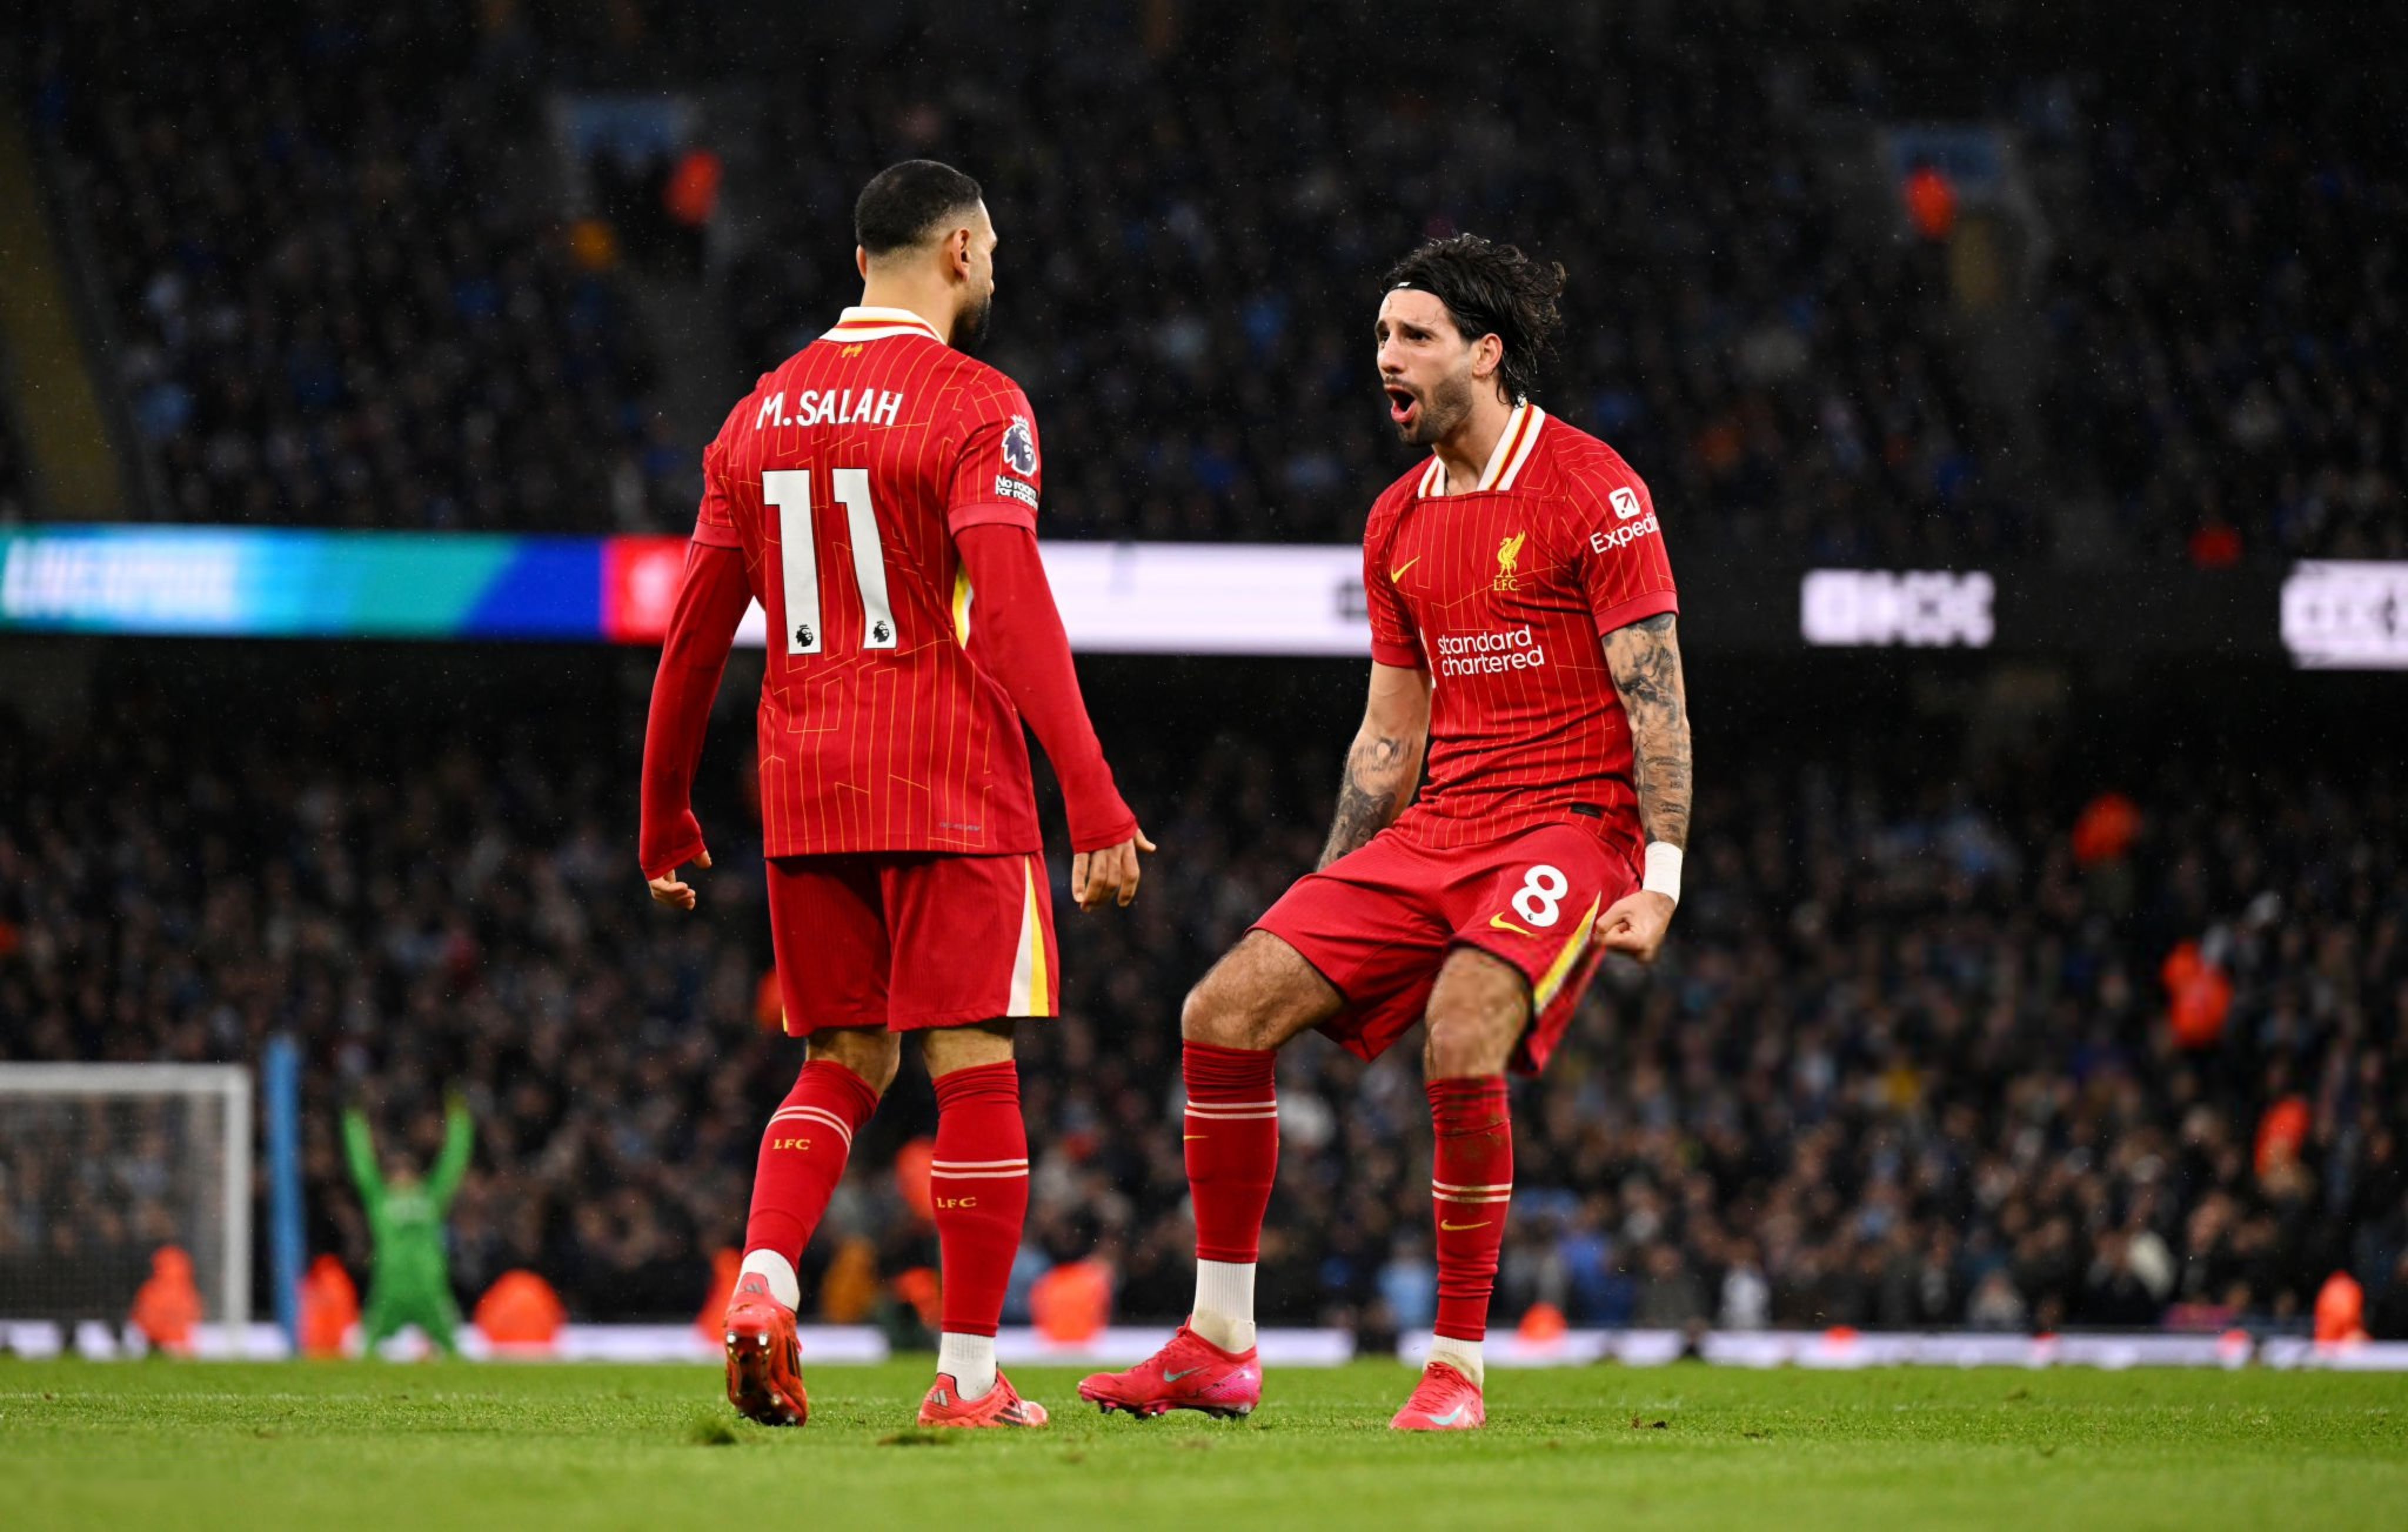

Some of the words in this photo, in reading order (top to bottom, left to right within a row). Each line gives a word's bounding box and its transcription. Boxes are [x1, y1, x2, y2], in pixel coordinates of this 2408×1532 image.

[995, 474, 1012, 489] No
[1014, 481, 1036, 500] room
[1590, 512, 1660, 554] Expedi
[761, 468, 897, 655] 11
[1437, 624, 1533, 655] standard
[1442, 645, 1545, 677] chartered
[1511, 865, 1568, 927] 8
[772, 1139, 811, 1150] LFC
[936, 1196, 977, 1208] LFC
